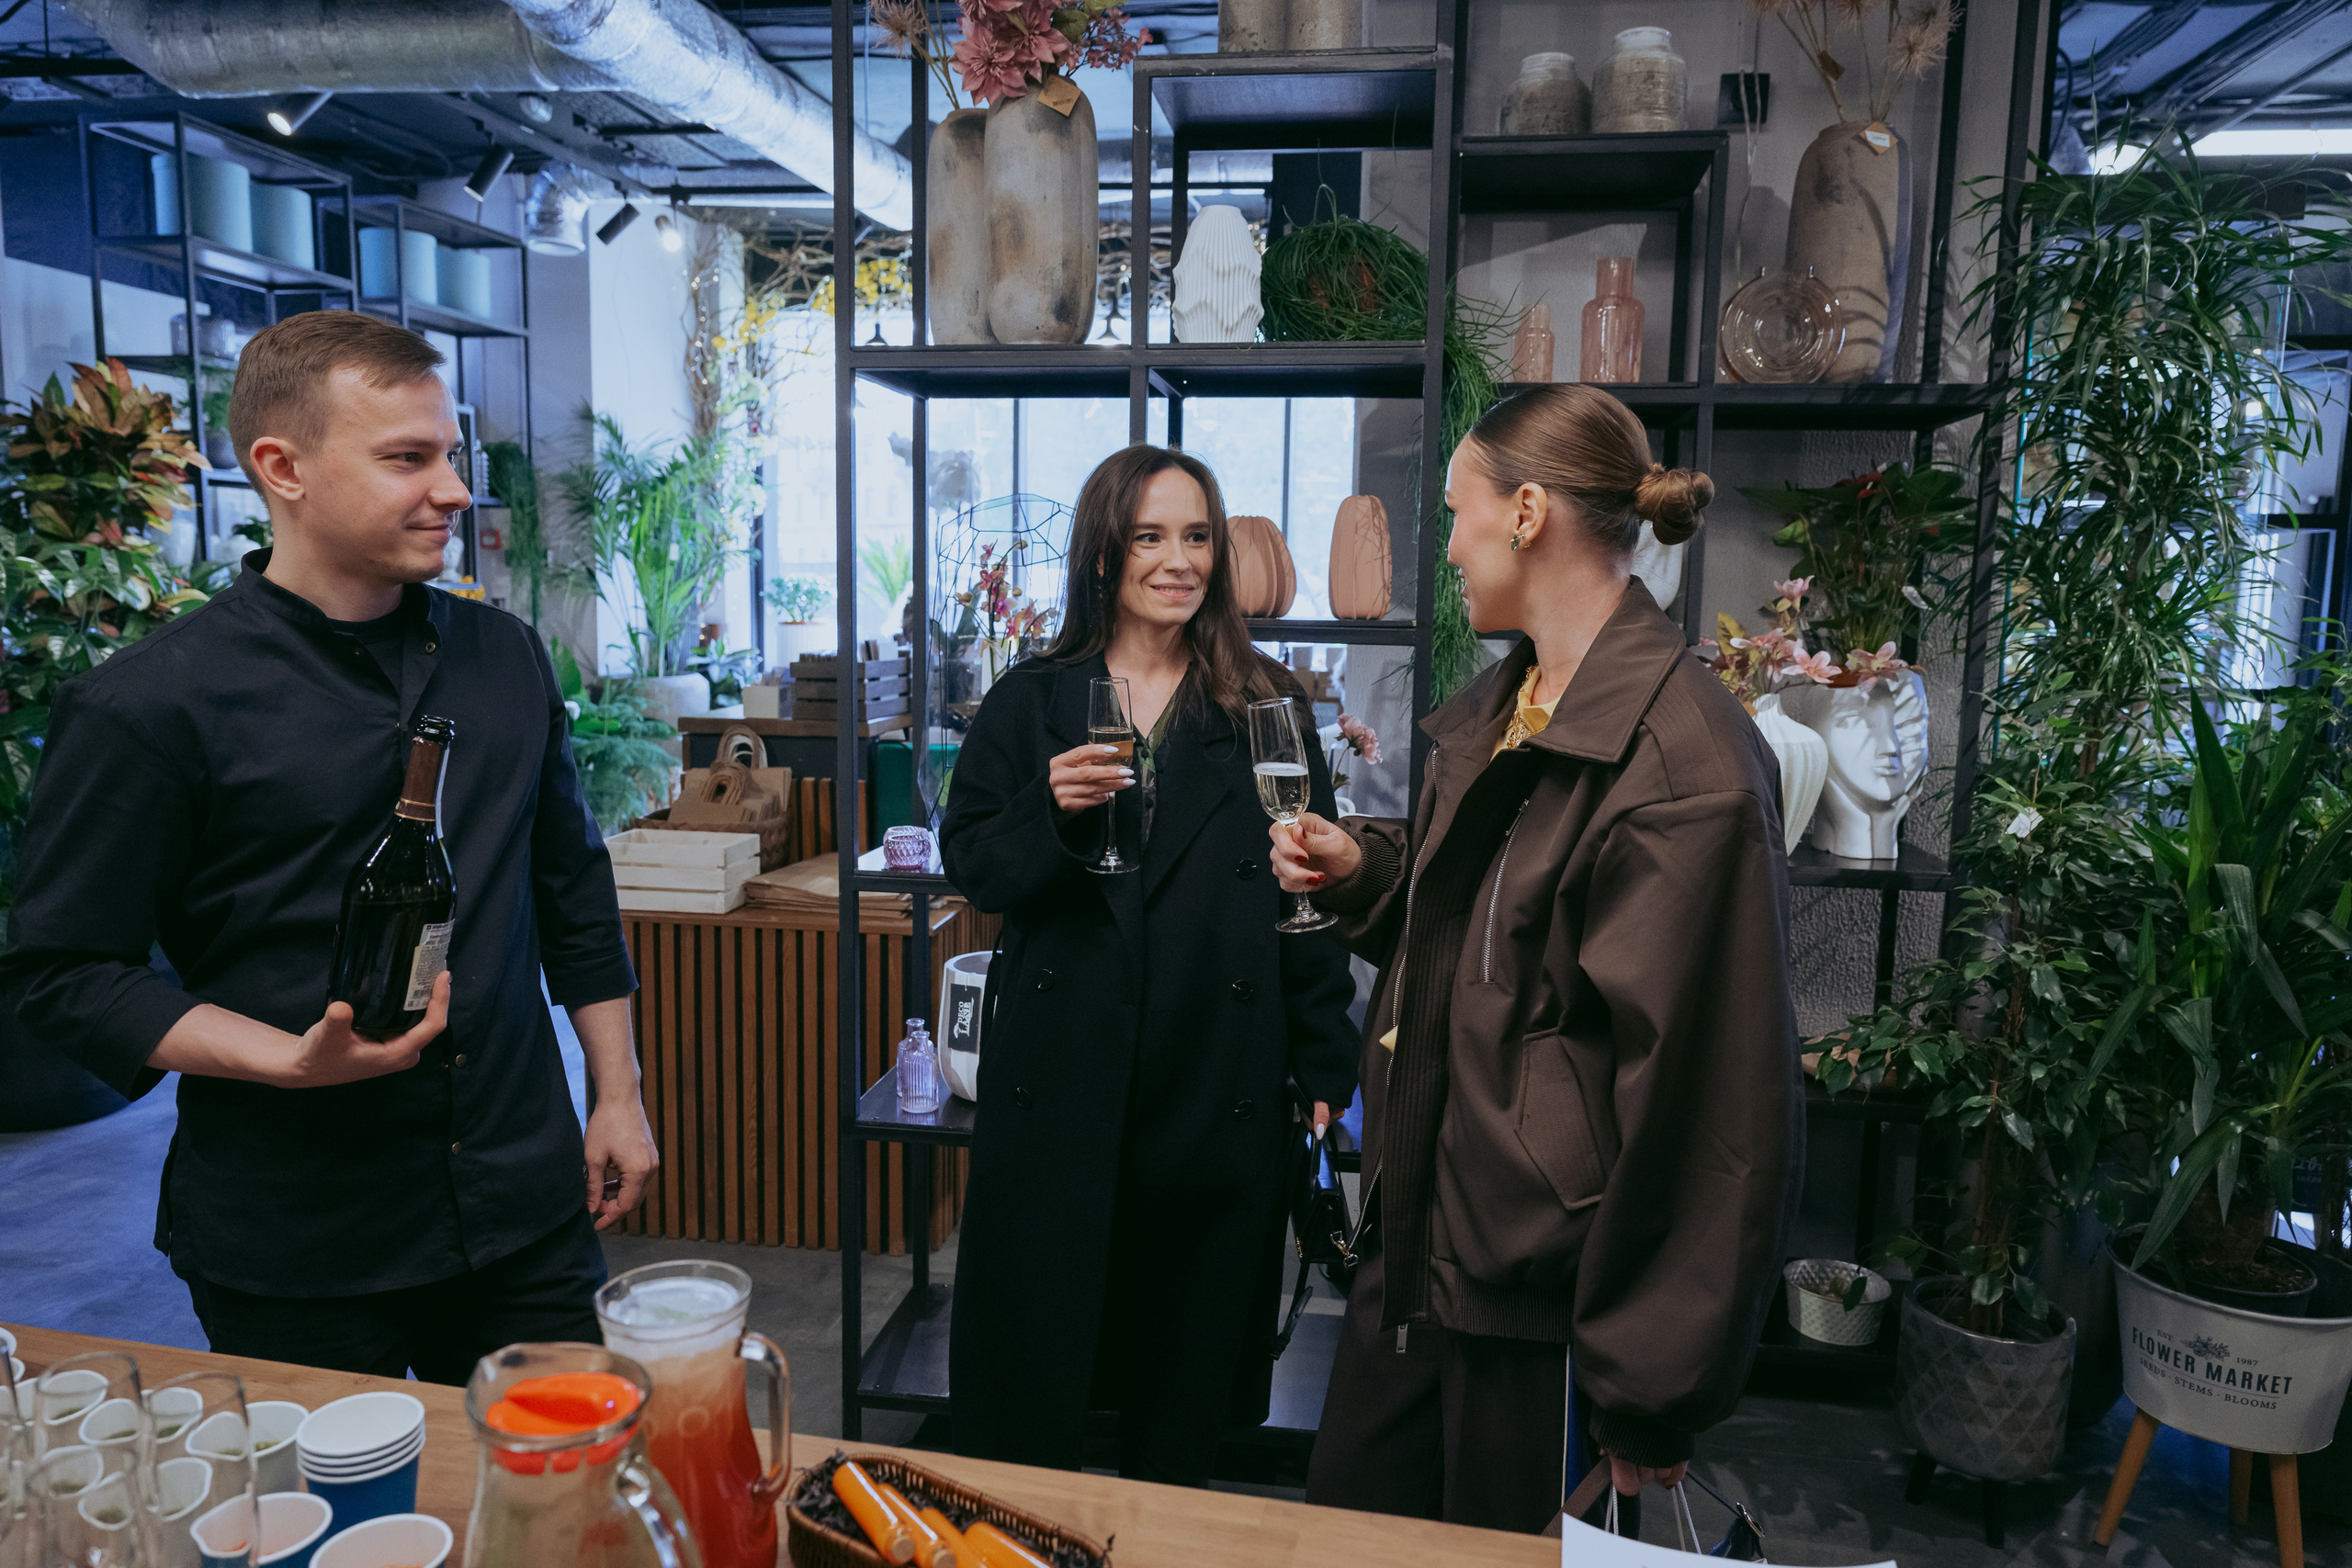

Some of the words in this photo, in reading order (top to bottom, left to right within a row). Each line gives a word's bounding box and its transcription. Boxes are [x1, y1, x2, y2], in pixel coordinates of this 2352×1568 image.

[2132, 1326, 2196, 1374] FLOWER
[2206, 1361, 2292, 1394] MARKET
[2140, 1357, 2165, 1378] SEEDS
[2174, 1376, 2213, 1396] STEMS
[2224, 1393, 2278, 1410] BLOOMS
[2235, 1358, 2258, 1367] 1987
